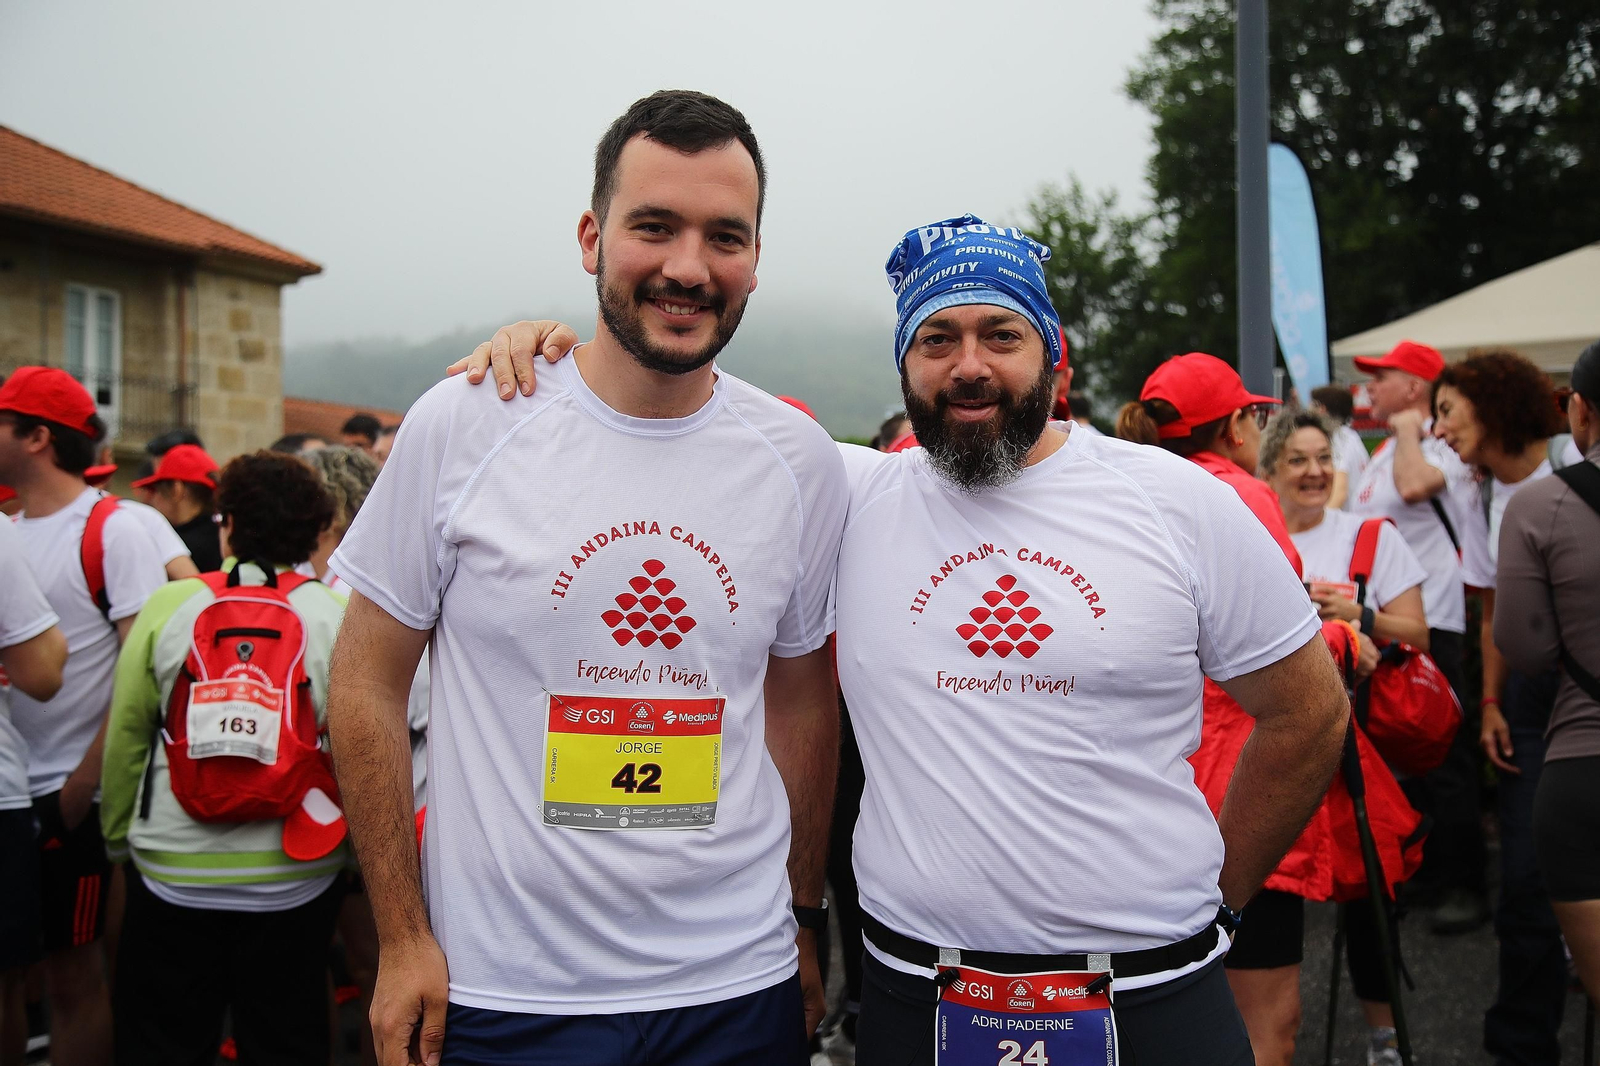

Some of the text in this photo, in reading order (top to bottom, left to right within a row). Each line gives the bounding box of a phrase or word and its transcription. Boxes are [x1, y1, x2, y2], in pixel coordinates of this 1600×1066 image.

[984, 236, 1019, 249] PROTIVITY
[955, 246, 1025, 267] PROTIVITY
[550, 520, 740, 614] III ANDAINA CAMPEIRA
[910, 588, 932, 614] III
[1016, 546, 1107, 620] CAMPEIRA
[577, 659, 708, 691] Facendo Piña!
[936, 669, 1075, 697] Facendo Piña!
[585, 708, 615, 724] GSI
[678, 712, 718, 725] Mediplus
[219, 717, 257, 735] 163
[615, 741, 663, 754] JORGE
[611, 762, 662, 794] 42
[968, 982, 993, 1000] GSI
[971, 1014, 1074, 1031] ADRI PADERNE
[997, 1040, 1049, 1066] 24
